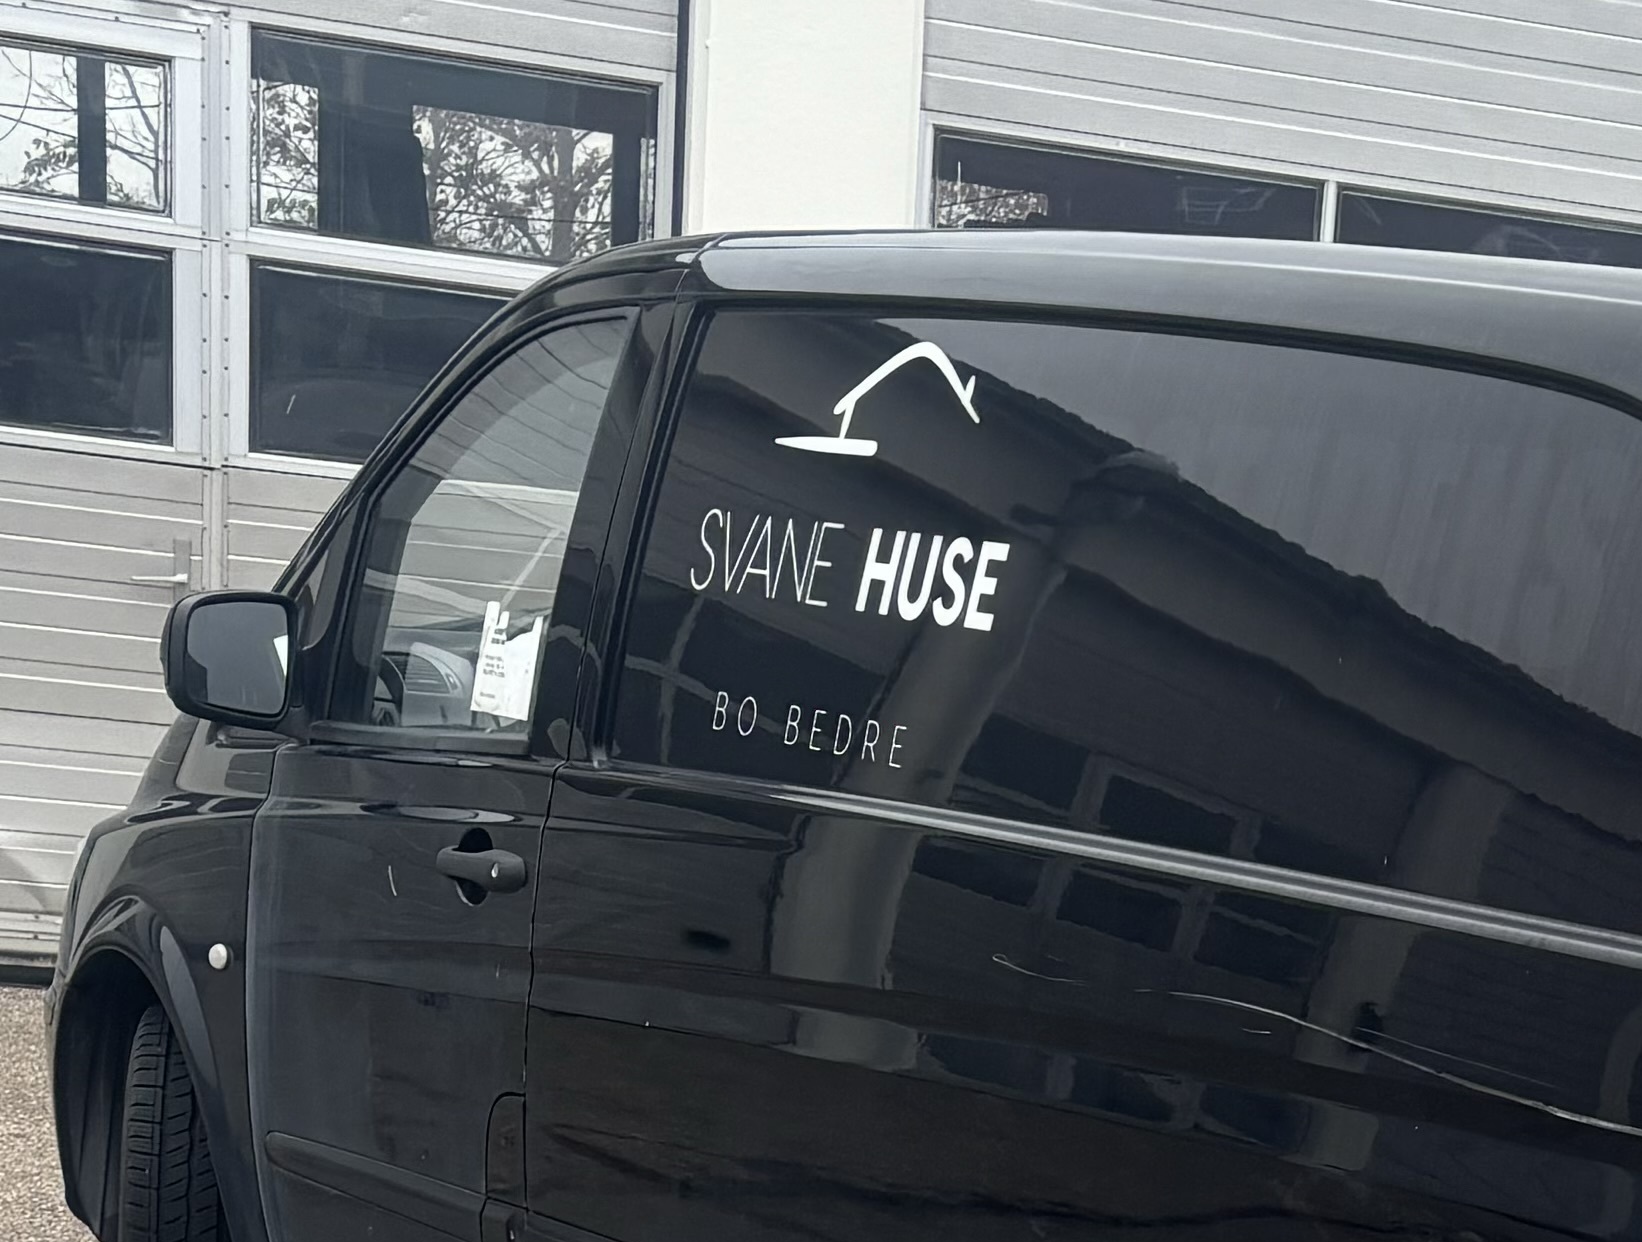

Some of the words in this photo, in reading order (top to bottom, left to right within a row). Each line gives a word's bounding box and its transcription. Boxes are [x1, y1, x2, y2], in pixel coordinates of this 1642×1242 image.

[690, 508, 845, 607] SVANE
[854, 527, 1011, 632] HUSE
[712, 691, 757, 736] BO
[783, 704, 908, 769] BEDRE
